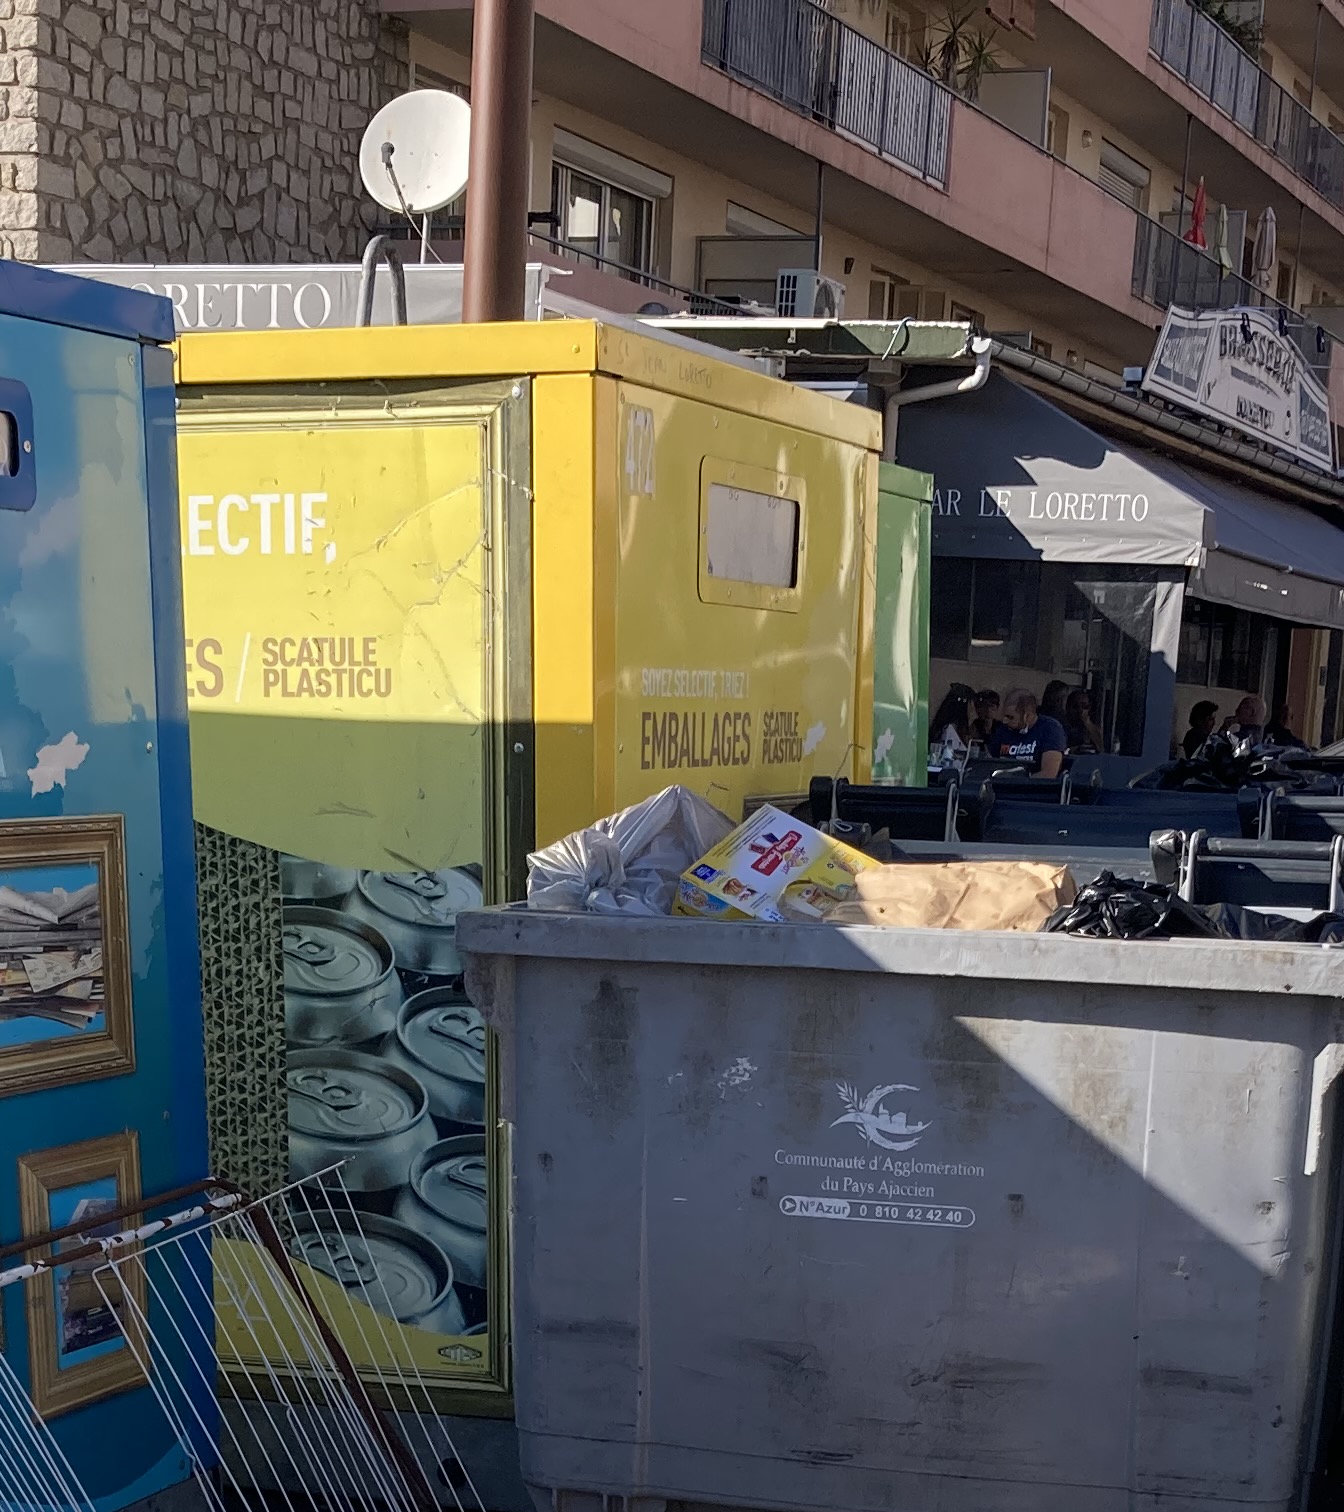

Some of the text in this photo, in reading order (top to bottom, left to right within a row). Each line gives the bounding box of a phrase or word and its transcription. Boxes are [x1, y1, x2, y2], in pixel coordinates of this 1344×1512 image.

[978, 490, 1012, 517] LE
[1028, 490, 1149, 522] LORETTO
[181, 491, 337, 563] ECTIF,
[262, 636, 378, 668] SCATULE
[262, 666, 393, 699] PLASTICU
[641, 668, 673, 698] SOYEZ
[720, 671, 744, 699] TRIEZ
[763, 710, 800, 737] SCATULE
[641, 711, 752, 770] EMBALLAGES
[761, 737, 804, 765] PLASTICU
[774, 1148, 986, 1178] Communauté d'Agglomération
[820, 1176, 936, 1200] du Pays Ajaccien
[874, 1204, 900, 1219] 810
[906, 1206, 923, 1221] 42
[925, 1208, 942, 1222] 42
[945, 1209, 963, 1223] 40
